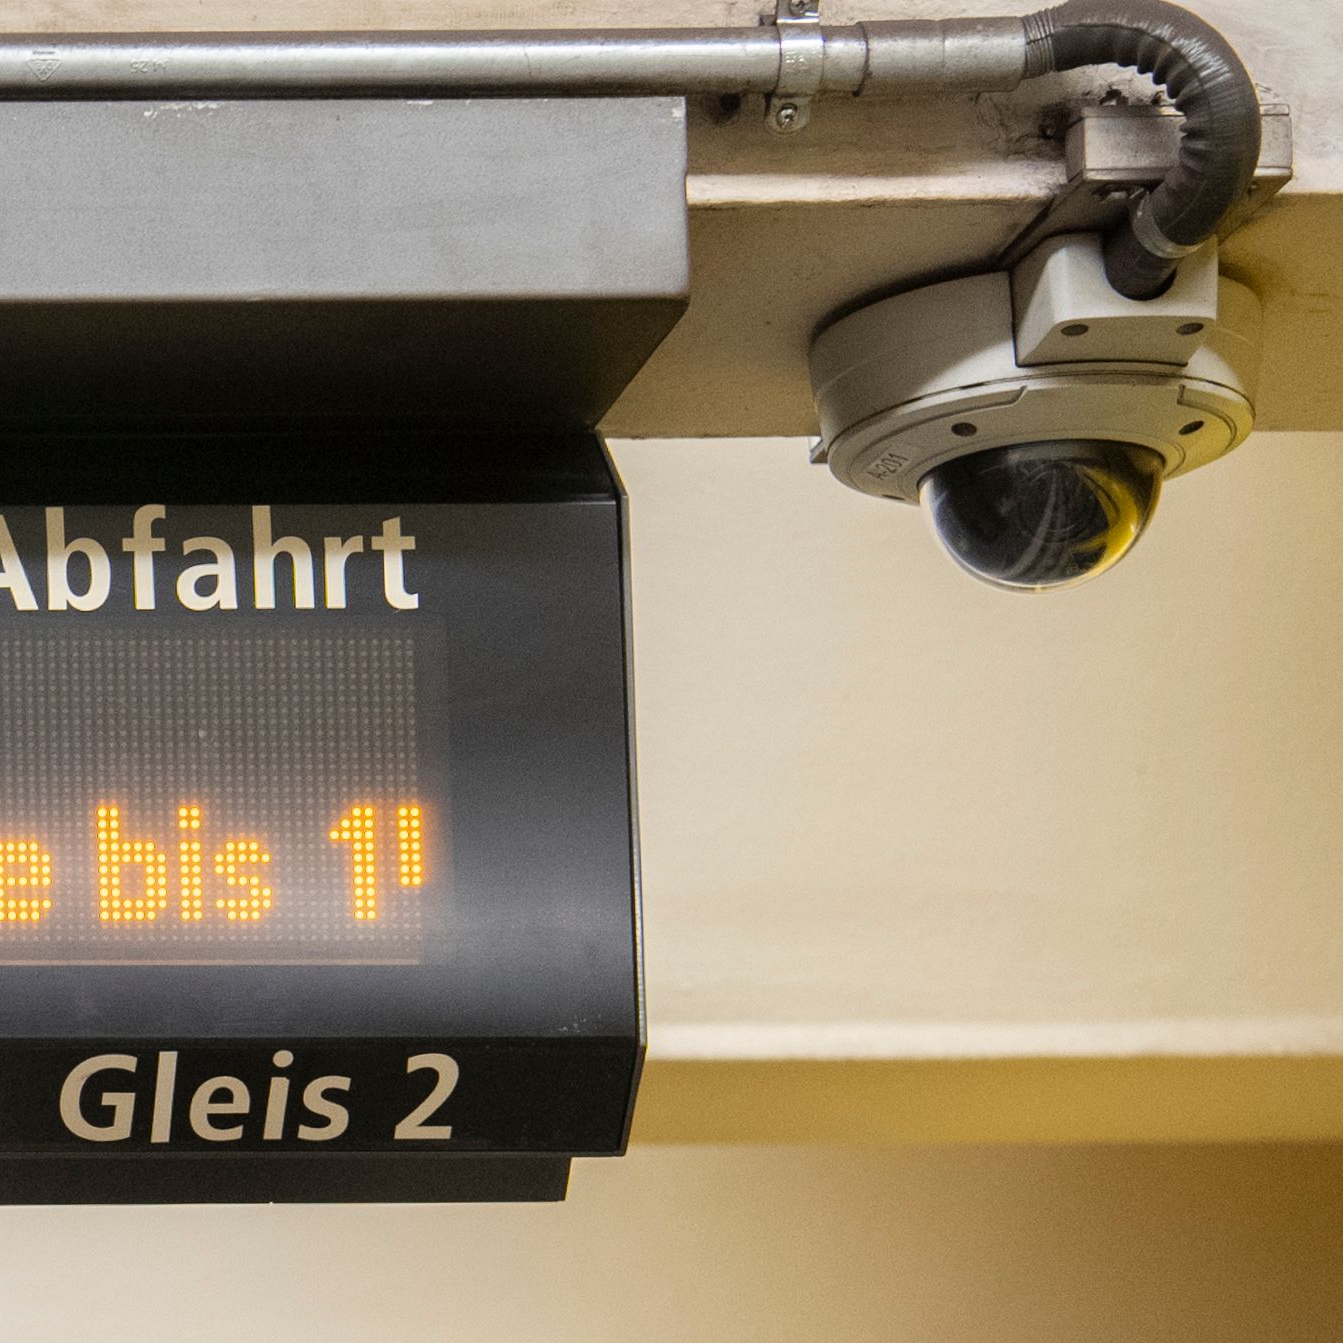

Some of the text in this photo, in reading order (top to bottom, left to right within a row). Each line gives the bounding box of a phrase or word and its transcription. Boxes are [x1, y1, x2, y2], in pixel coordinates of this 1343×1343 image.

[93, 802, 276, 925] bis
[58, 1049, 462, 1144] Gleis 2
